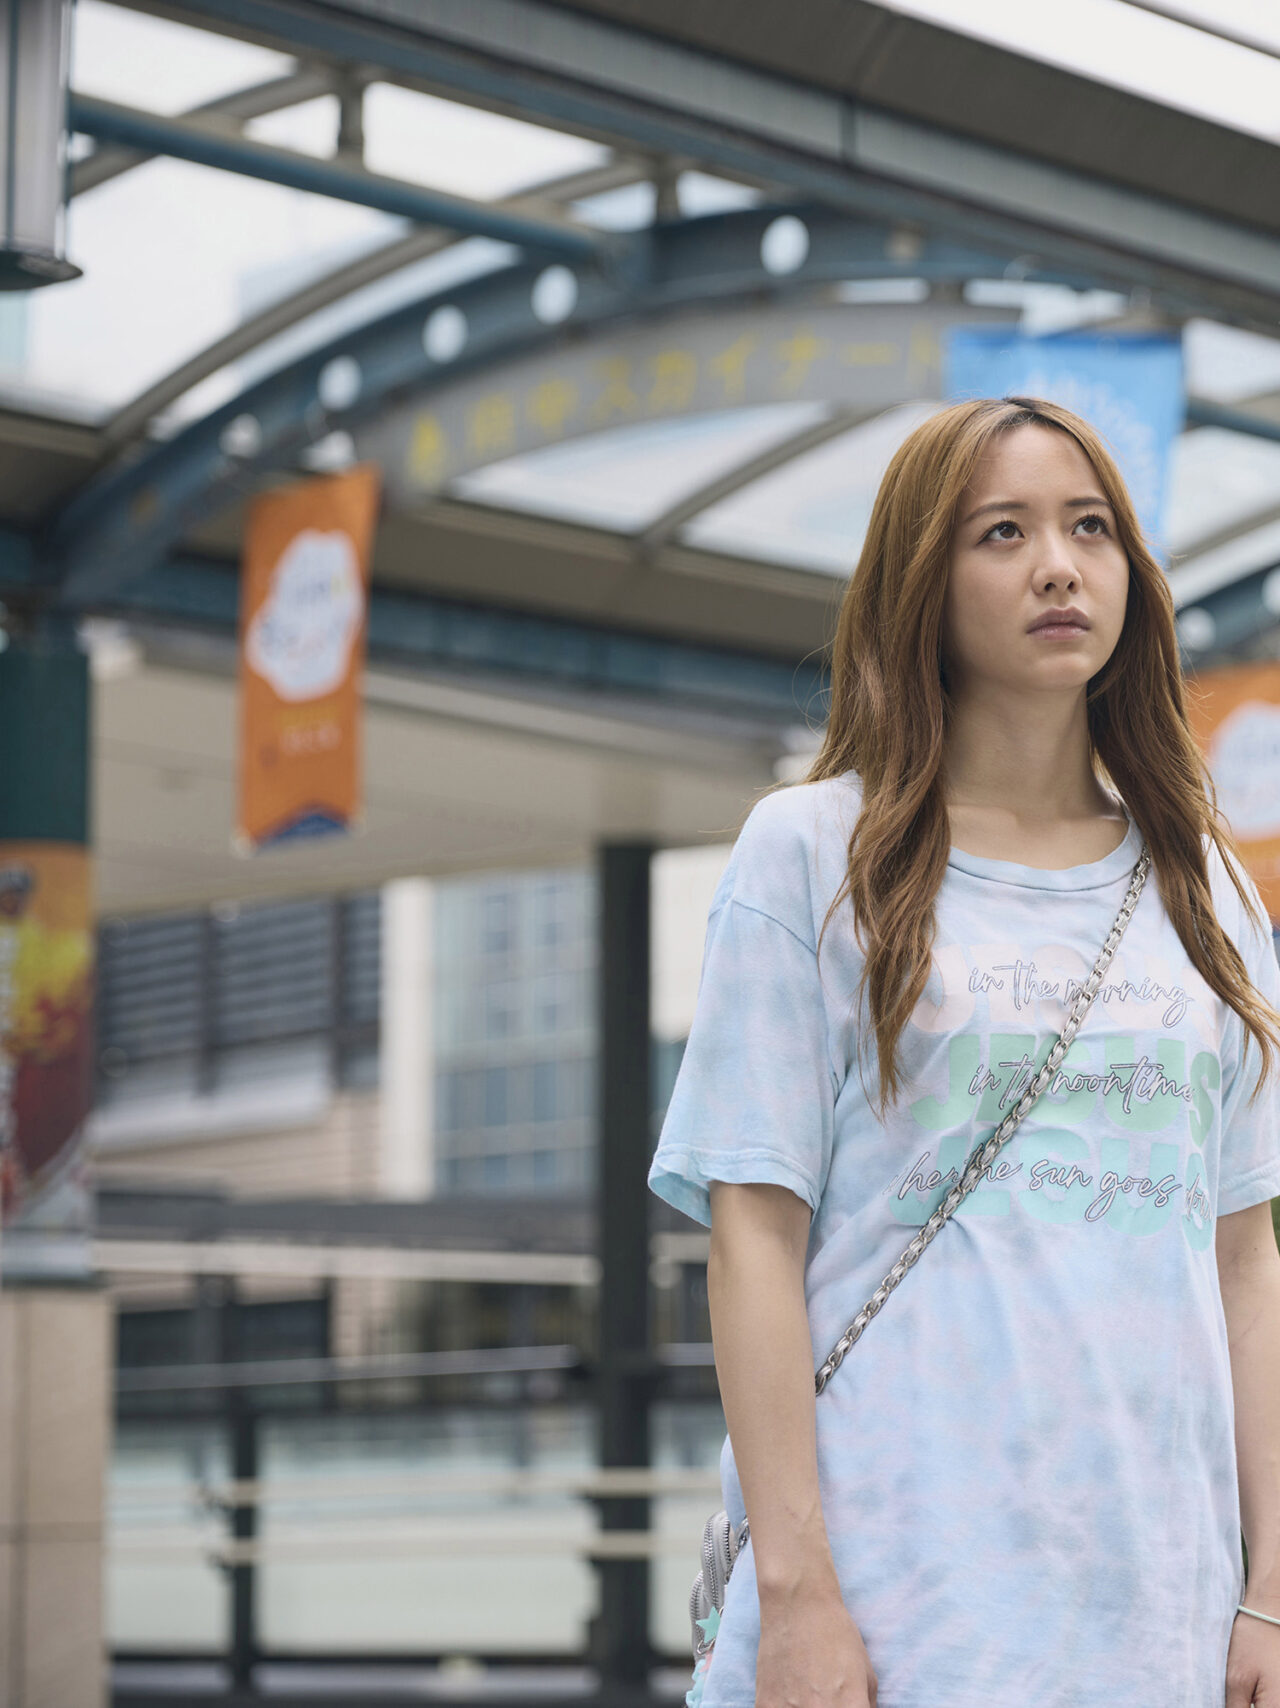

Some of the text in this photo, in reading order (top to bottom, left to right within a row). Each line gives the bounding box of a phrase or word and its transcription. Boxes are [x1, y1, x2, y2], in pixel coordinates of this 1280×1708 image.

[968, 959, 1195, 1029] in the mrning
[909, 1033, 1221, 1148] JESUS
[968, 1063, 1001, 1096] in
[998, 1053, 1036, 1110] th
[1029, 1159, 1093, 1191] sun
[1084, 1168, 1183, 1222] goes
